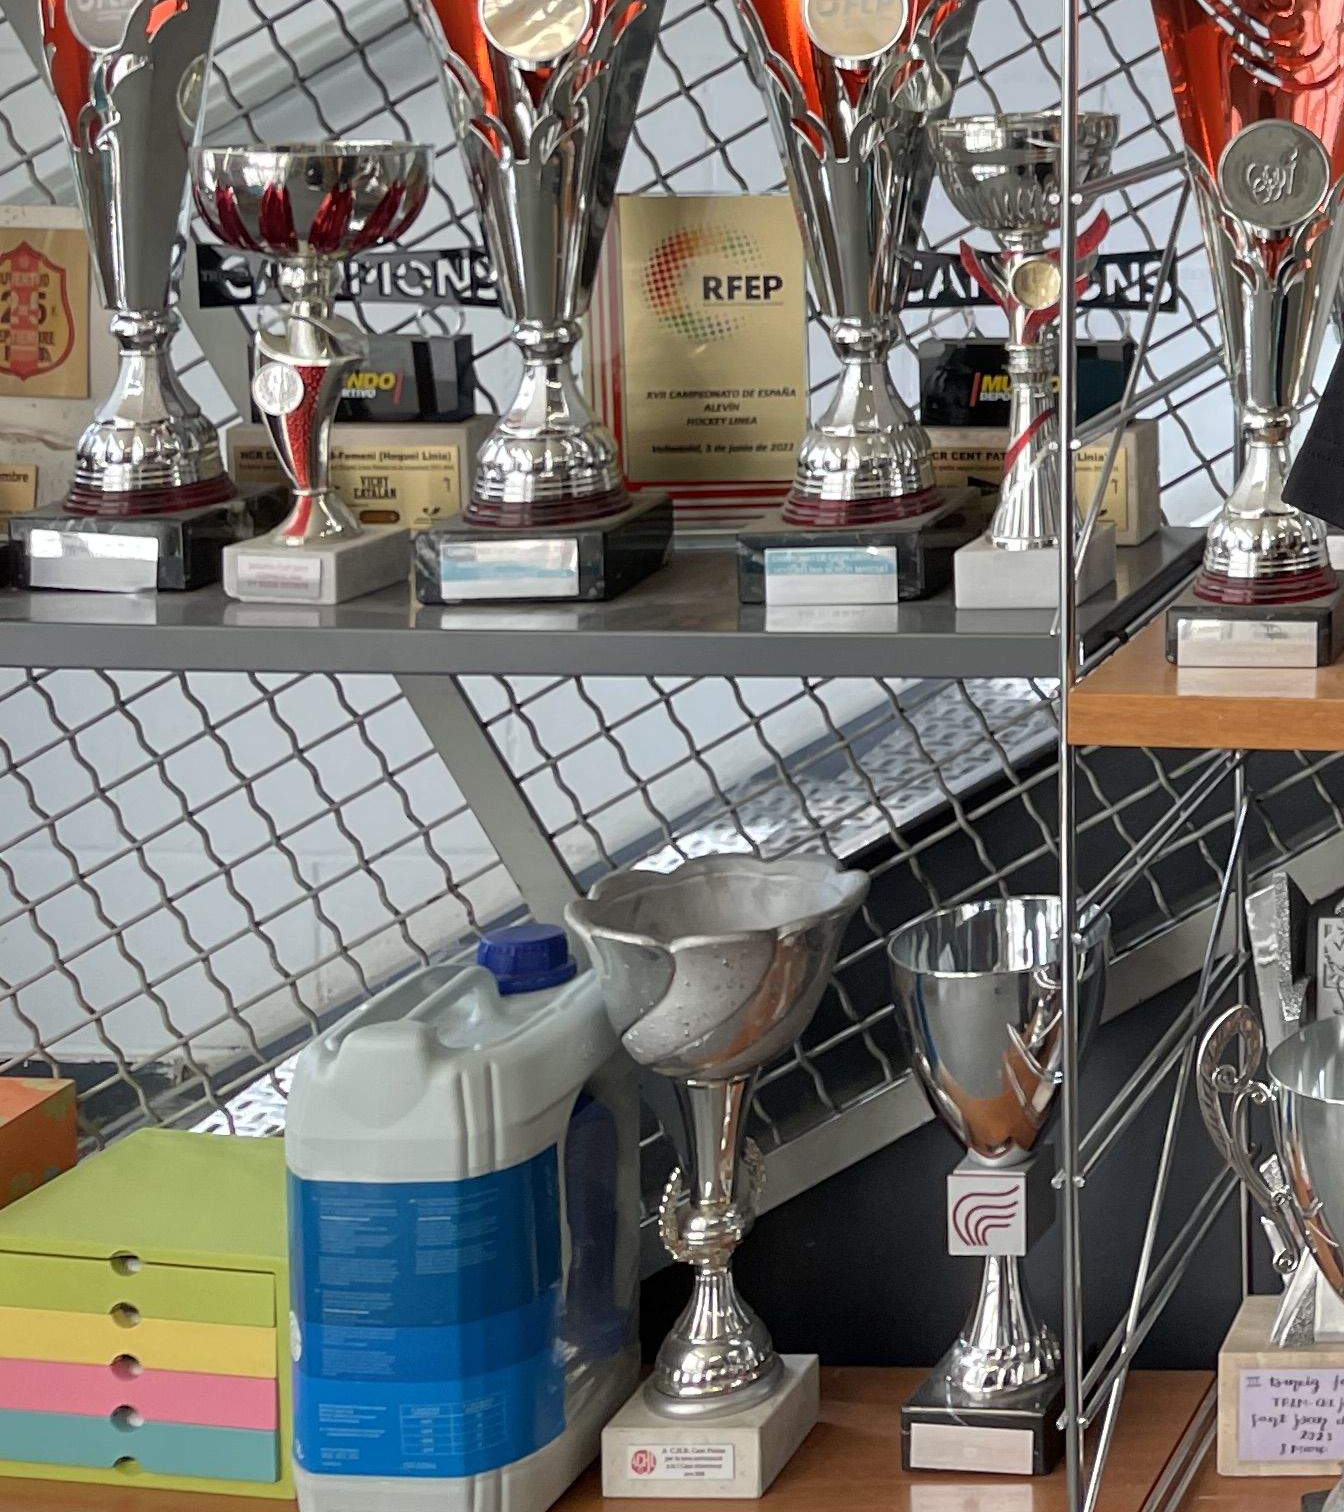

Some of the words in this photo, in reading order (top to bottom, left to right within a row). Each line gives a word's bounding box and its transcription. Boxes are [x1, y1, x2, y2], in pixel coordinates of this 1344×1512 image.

[703, 275, 784, 300] RFEP
[669, 390, 740, 399] CAMPEONATO
[758, 387, 796, 398] ESPAÑA
[686, 417, 727, 426] HOCKEY
[713, 444, 726, 453] de
[360, 476, 389, 487] VICHY
